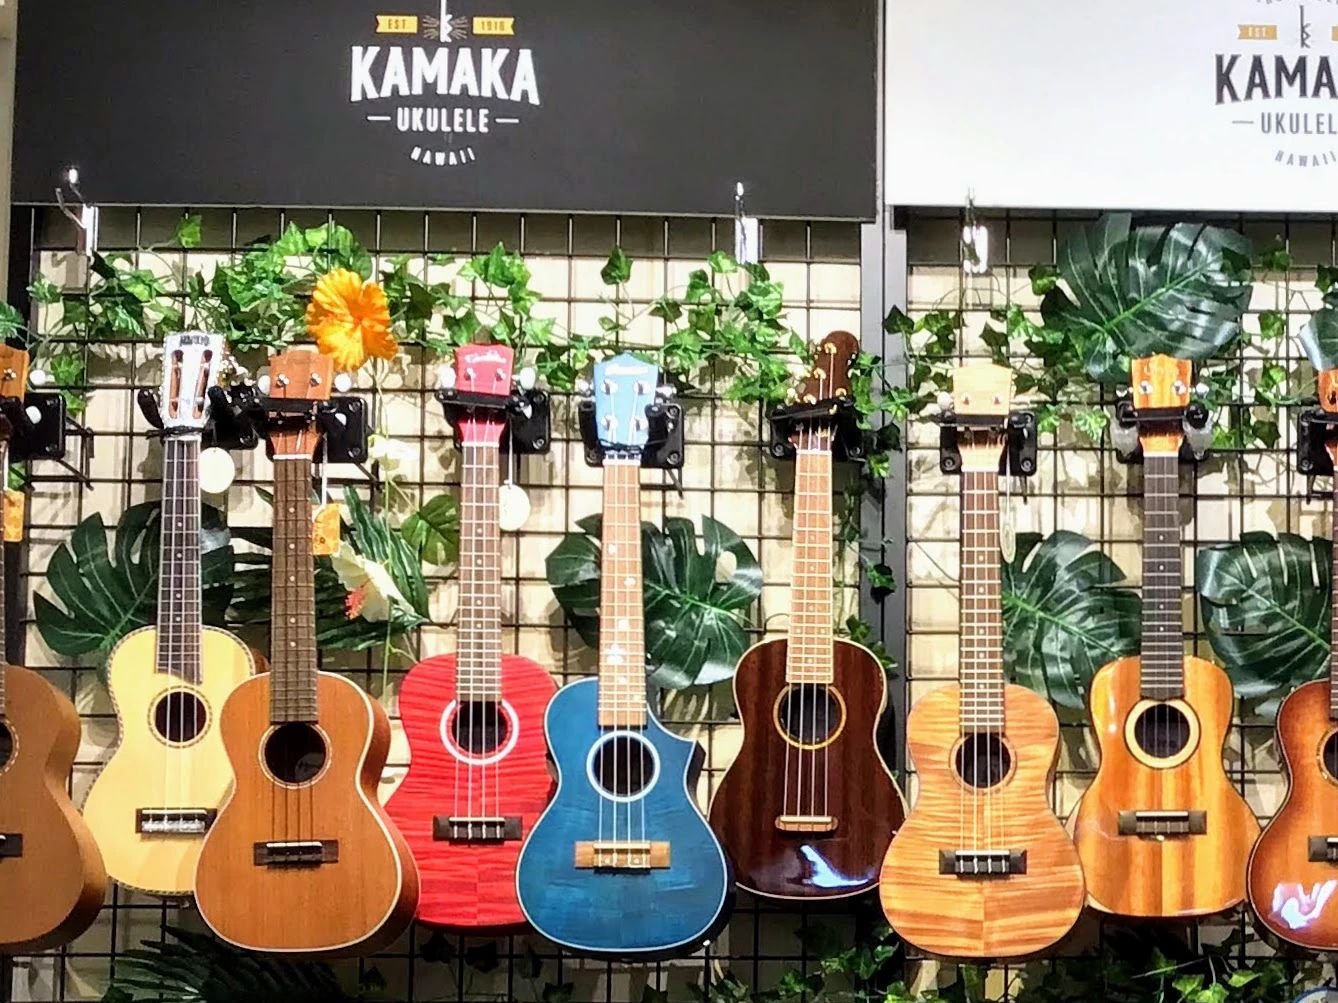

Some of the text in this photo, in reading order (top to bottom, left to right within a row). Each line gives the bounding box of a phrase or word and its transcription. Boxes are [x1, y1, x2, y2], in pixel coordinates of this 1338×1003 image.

[387, 18, 408, 30] EST
[1247, 26, 1267, 38] EST
[350, 46, 541, 106] KAMAKA
[396, 107, 490, 133] UKULELE
[410, 146, 476, 166] HAWAII
[1274, 150, 1337, 168] HAWAII
